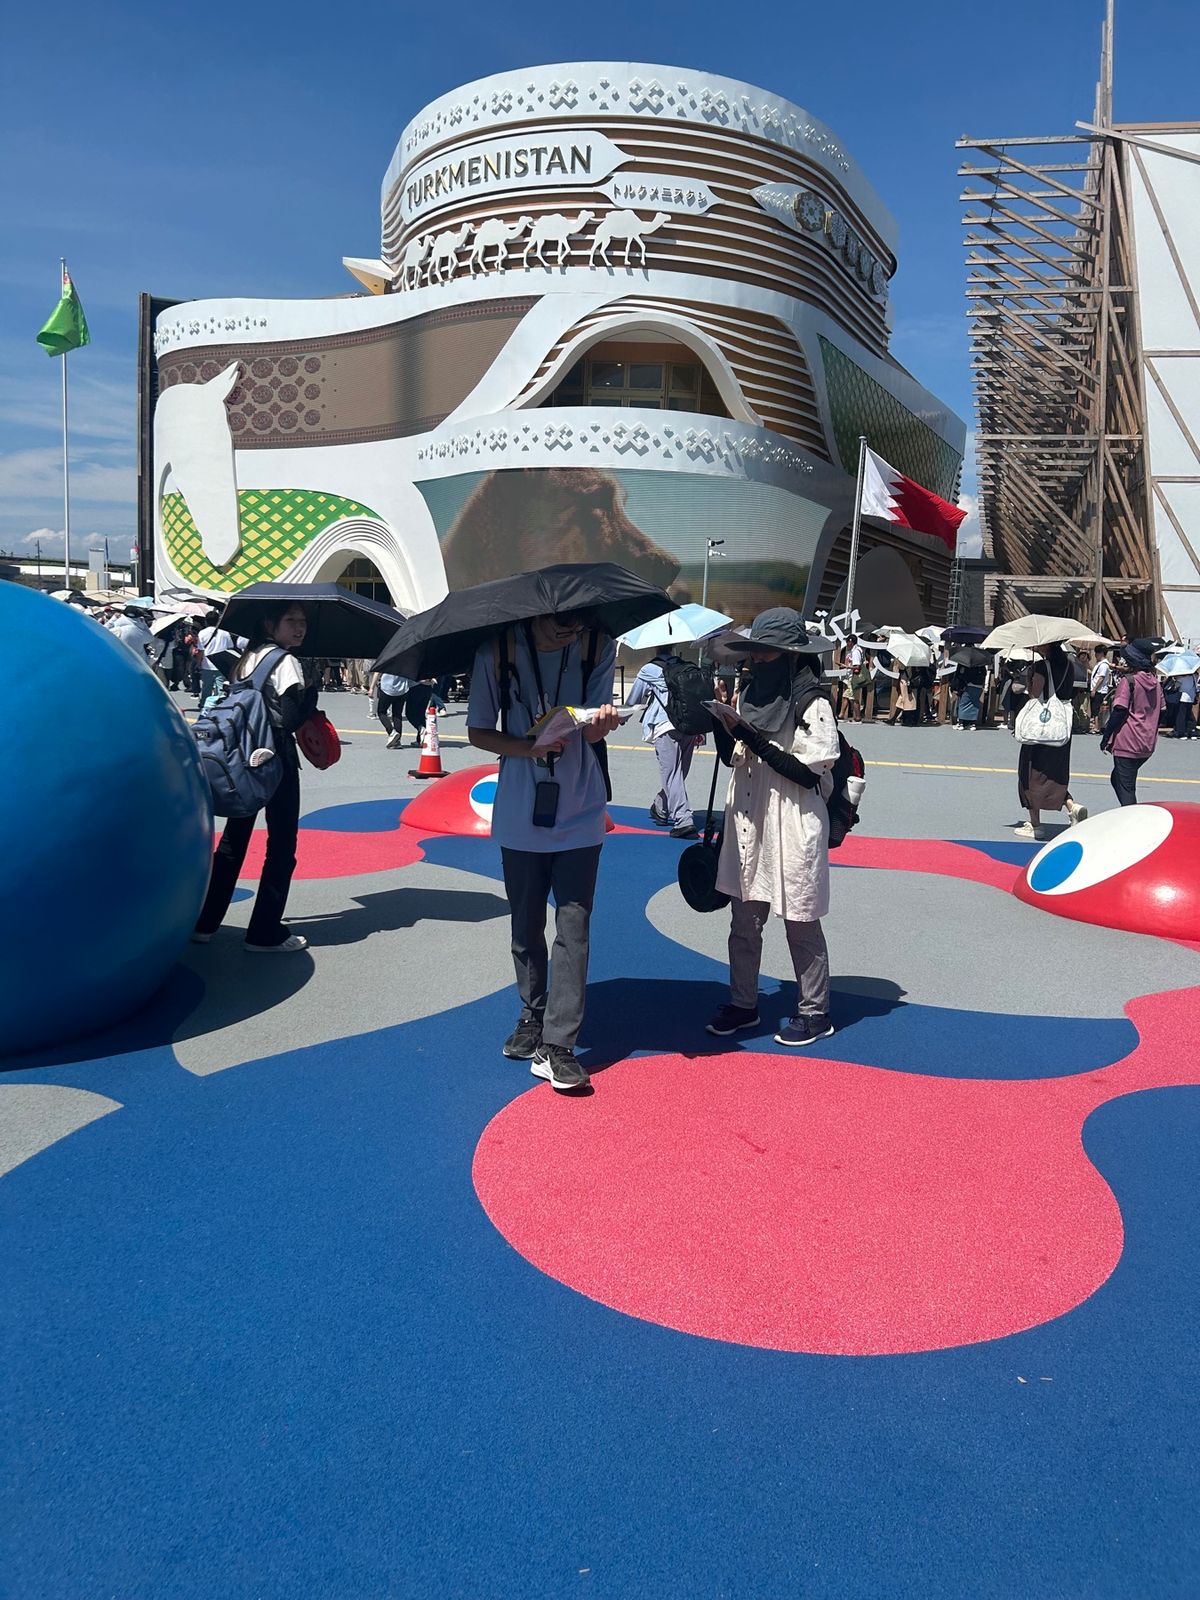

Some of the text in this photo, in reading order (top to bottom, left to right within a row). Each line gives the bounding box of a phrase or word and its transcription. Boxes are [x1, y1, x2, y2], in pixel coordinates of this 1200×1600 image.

[407, 144, 592, 211] TURKMENISTAN
[613, 183, 708, 207] トルクメニスタン
